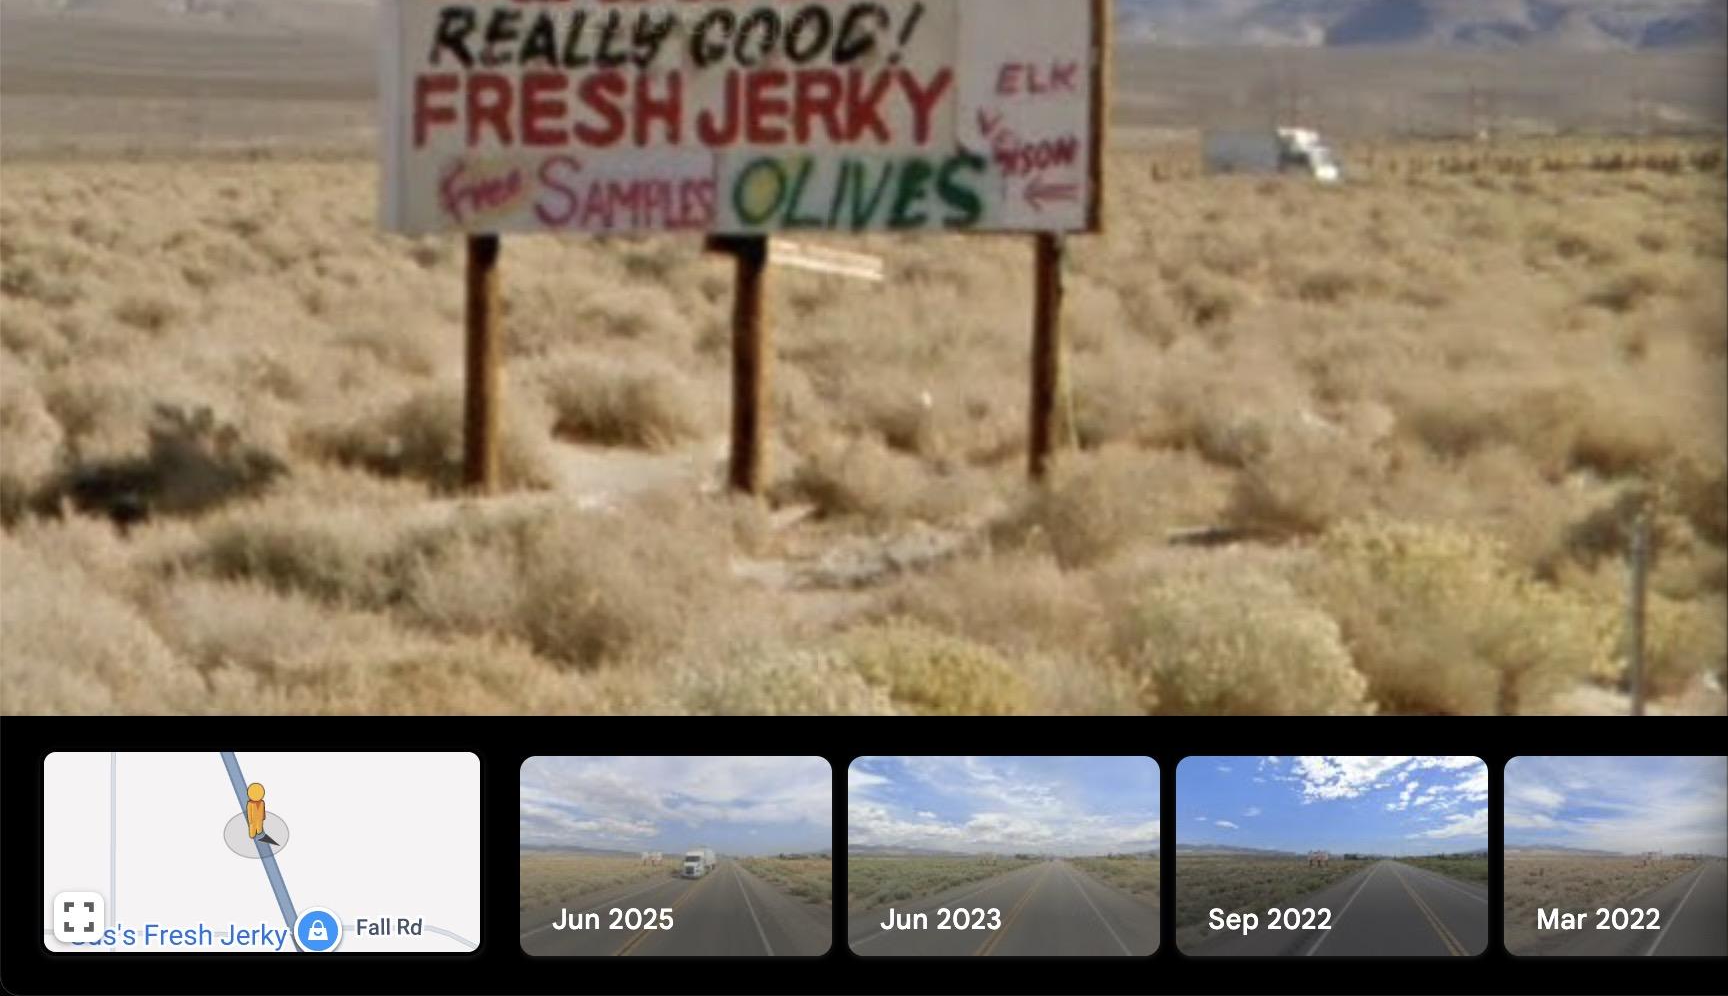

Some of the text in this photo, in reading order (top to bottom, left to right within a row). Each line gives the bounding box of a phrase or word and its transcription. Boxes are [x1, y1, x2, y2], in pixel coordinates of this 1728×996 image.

[429, 1, 924, 69] REALLY GOOD!
[996, 61, 1079, 96] ELK
[412, 68, 952, 150] FRESH JERKY
[732, 150, 986, 231] OLIVES
[356, 917, 423, 936] Fall Rd
[552, 907, 674, 930] Jun 2025
[880, 907, 1002, 930] Jun 2023
[1208, 907, 1332, 936] Sep 2022
[1536, 907, 1660, 930] Mar 2022
[145, 924, 212, 946] Fresh
[220, 924, 288, 952] Jerky
